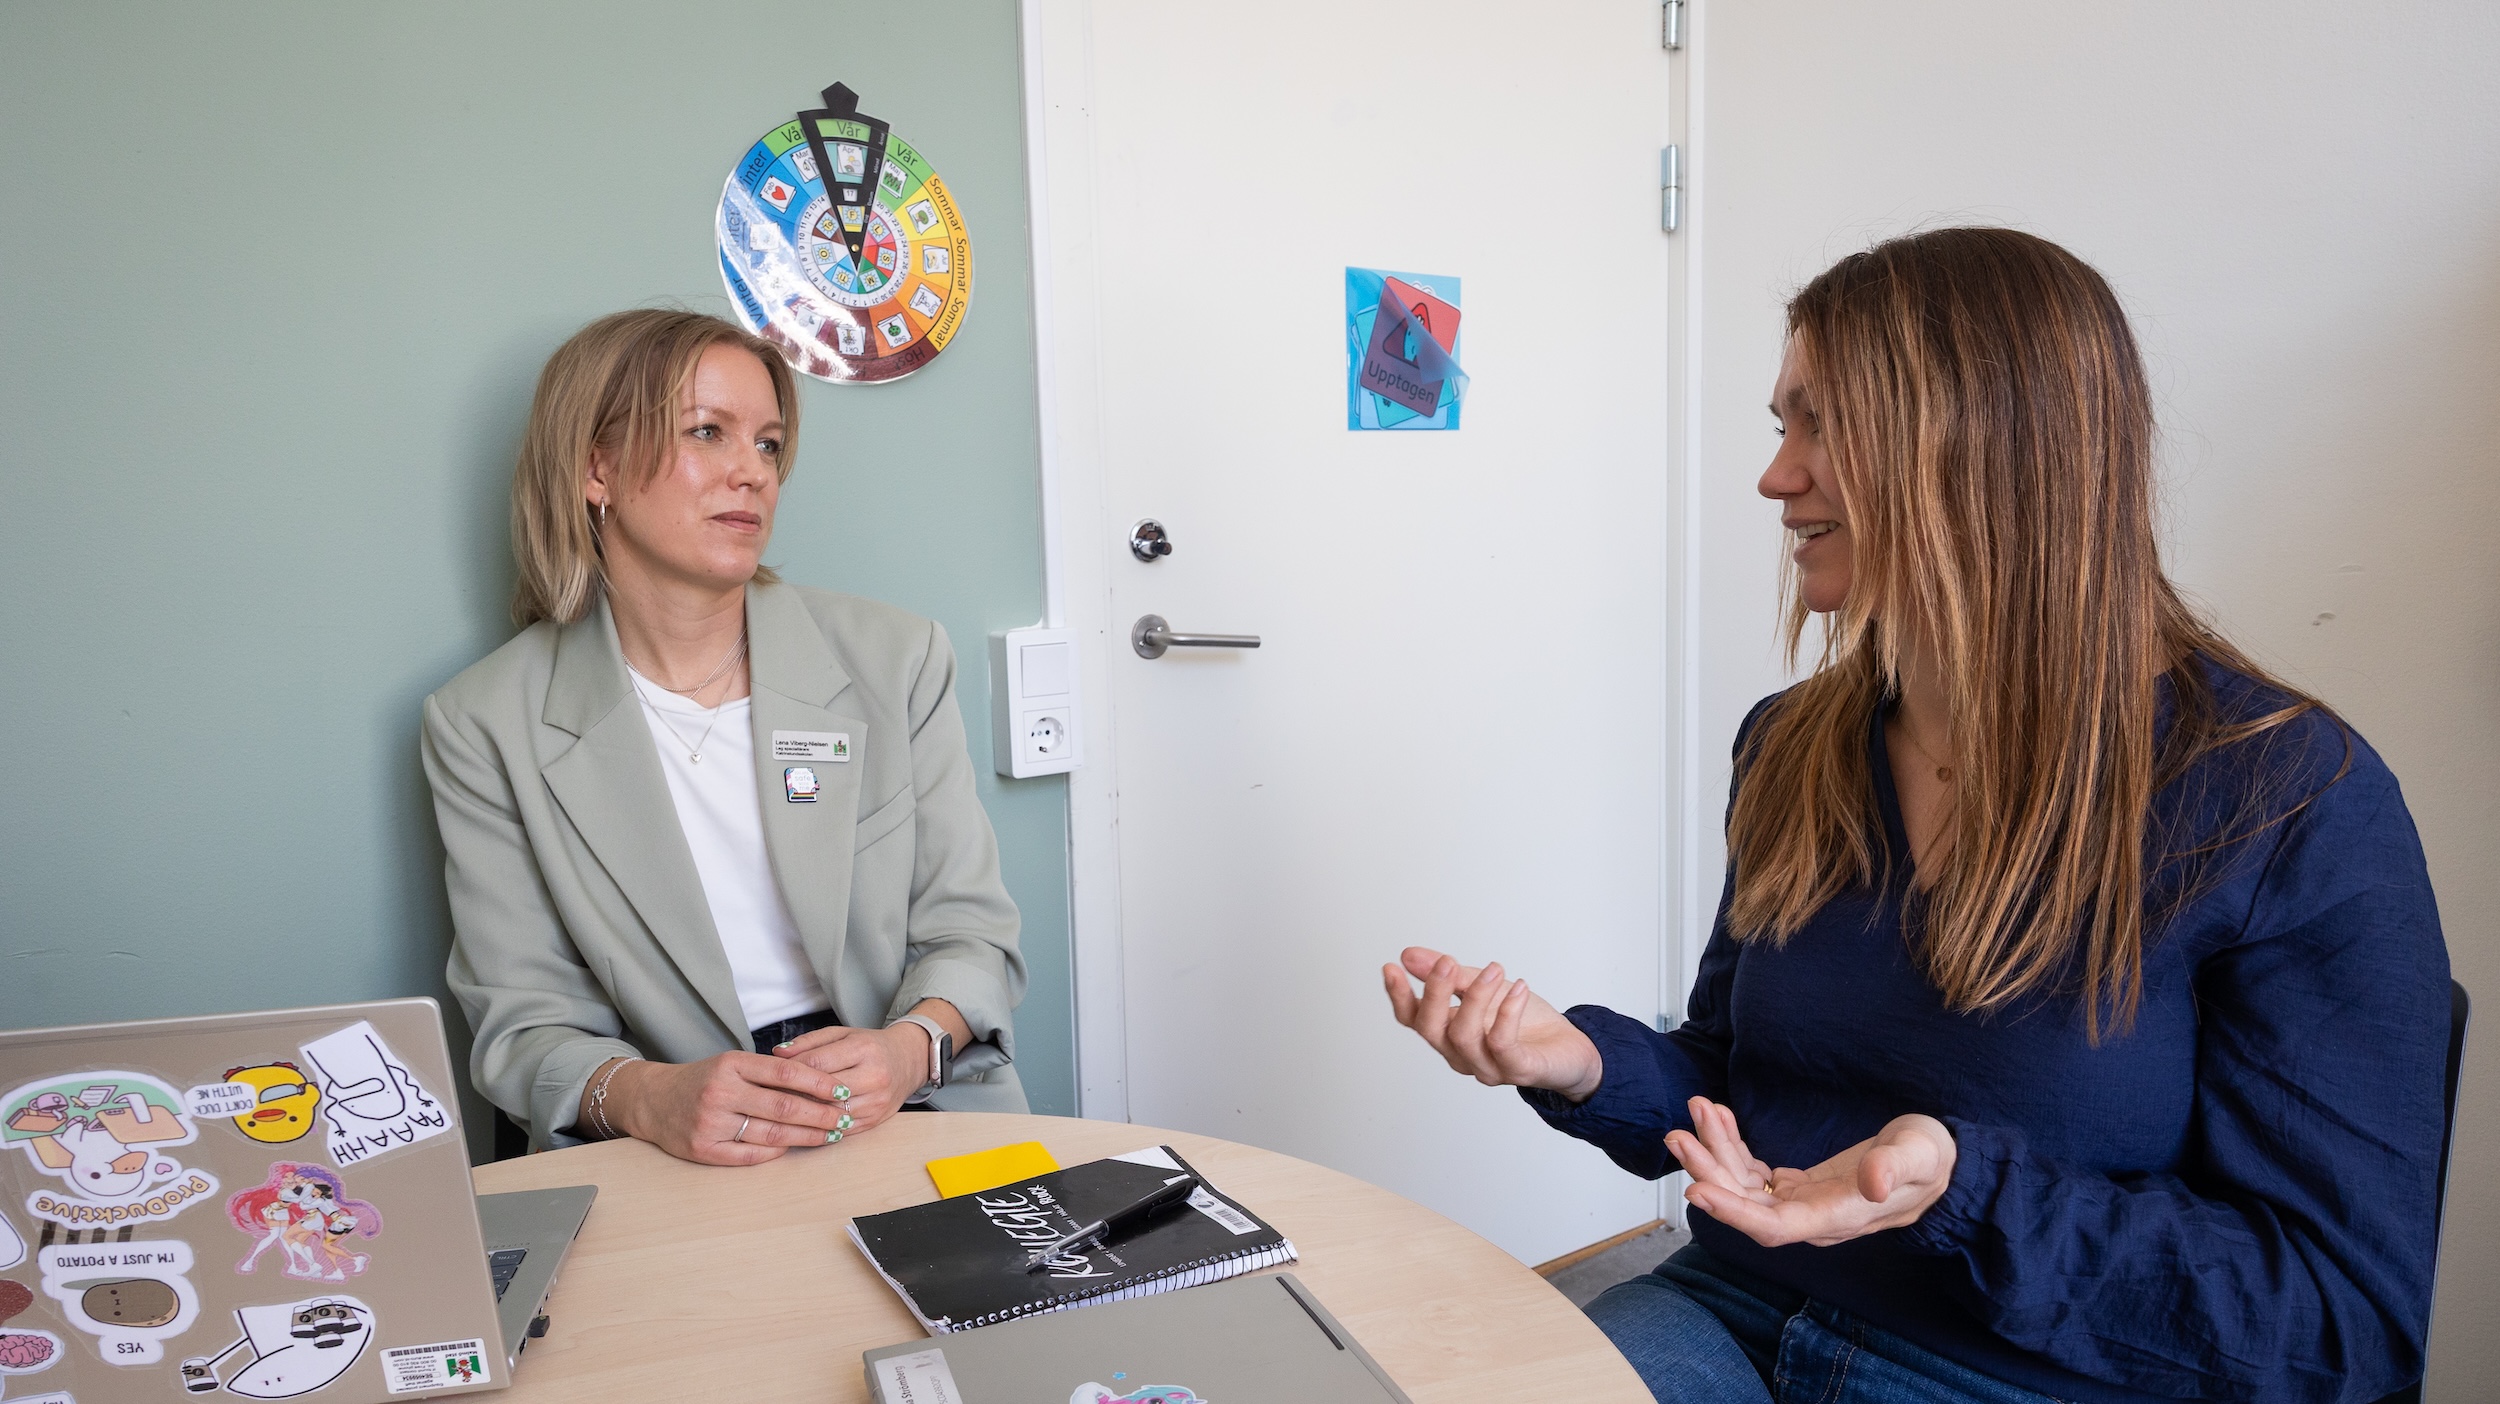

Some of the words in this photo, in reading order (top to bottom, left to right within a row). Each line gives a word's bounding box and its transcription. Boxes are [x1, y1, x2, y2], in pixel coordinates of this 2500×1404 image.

[836, 121, 861, 138] Vår
[795, 148, 809, 160] Mar
[841, 145, 855, 155] Apr
[896, 143, 918, 166] Vår
[888, 163, 902, 177] Maj
[763, 181, 775, 195] Feb
[846, 190, 854, 198] 17
[817, 196, 825, 205] 14
[876, 201, 884, 210] 20
[929, 177, 962, 232] Sommar
[809, 203, 817, 211] 13
[925, 204, 935, 218] Jun
[804, 211, 812, 220] 12
[884, 209, 893, 218] 21
[800, 221, 807, 229] 11
[891, 218, 900, 227] 22
[799, 232, 805, 240] 10
[897, 229, 905, 237] 23
[901, 240, 908, 248] 24
[902, 251, 909, 259] 25
[902, 261, 909, 270] 26
[956, 237, 967, 294] Sommar
[900, 271, 906, 280] 27
[894, 279, 902, 288] 28
[880, 293, 888, 301] 30
[888, 287, 896, 296] 29
[733, 277, 763, 324] Vinter
[928, 301, 939, 314] Aug
[934, 297, 965, 348] Sommar
[893, 335, 907, 344] Sep
[845, 346, 859, 354] Okt
[891, 346, 925, 370] Höst
[1368, 360, 1435, 404] Upptagen
[213, 1085, 243, 1099] WITH
[194, 1102, 221, 1115] DUCK
[224, 1099, 254, 1112] DON'T
[1026, 1183, 1057, 1206] BLOCK
[57, 1256, 104, 1268] POTATO
[108, 1255, 118, 1266] A
[122, 1254, 153, 1266] JUST
[157, 1252, 175, 1264] I'M
[116, 1342, 144, 1354] YES
[894, 1365, 913, 1399] Strömberg
